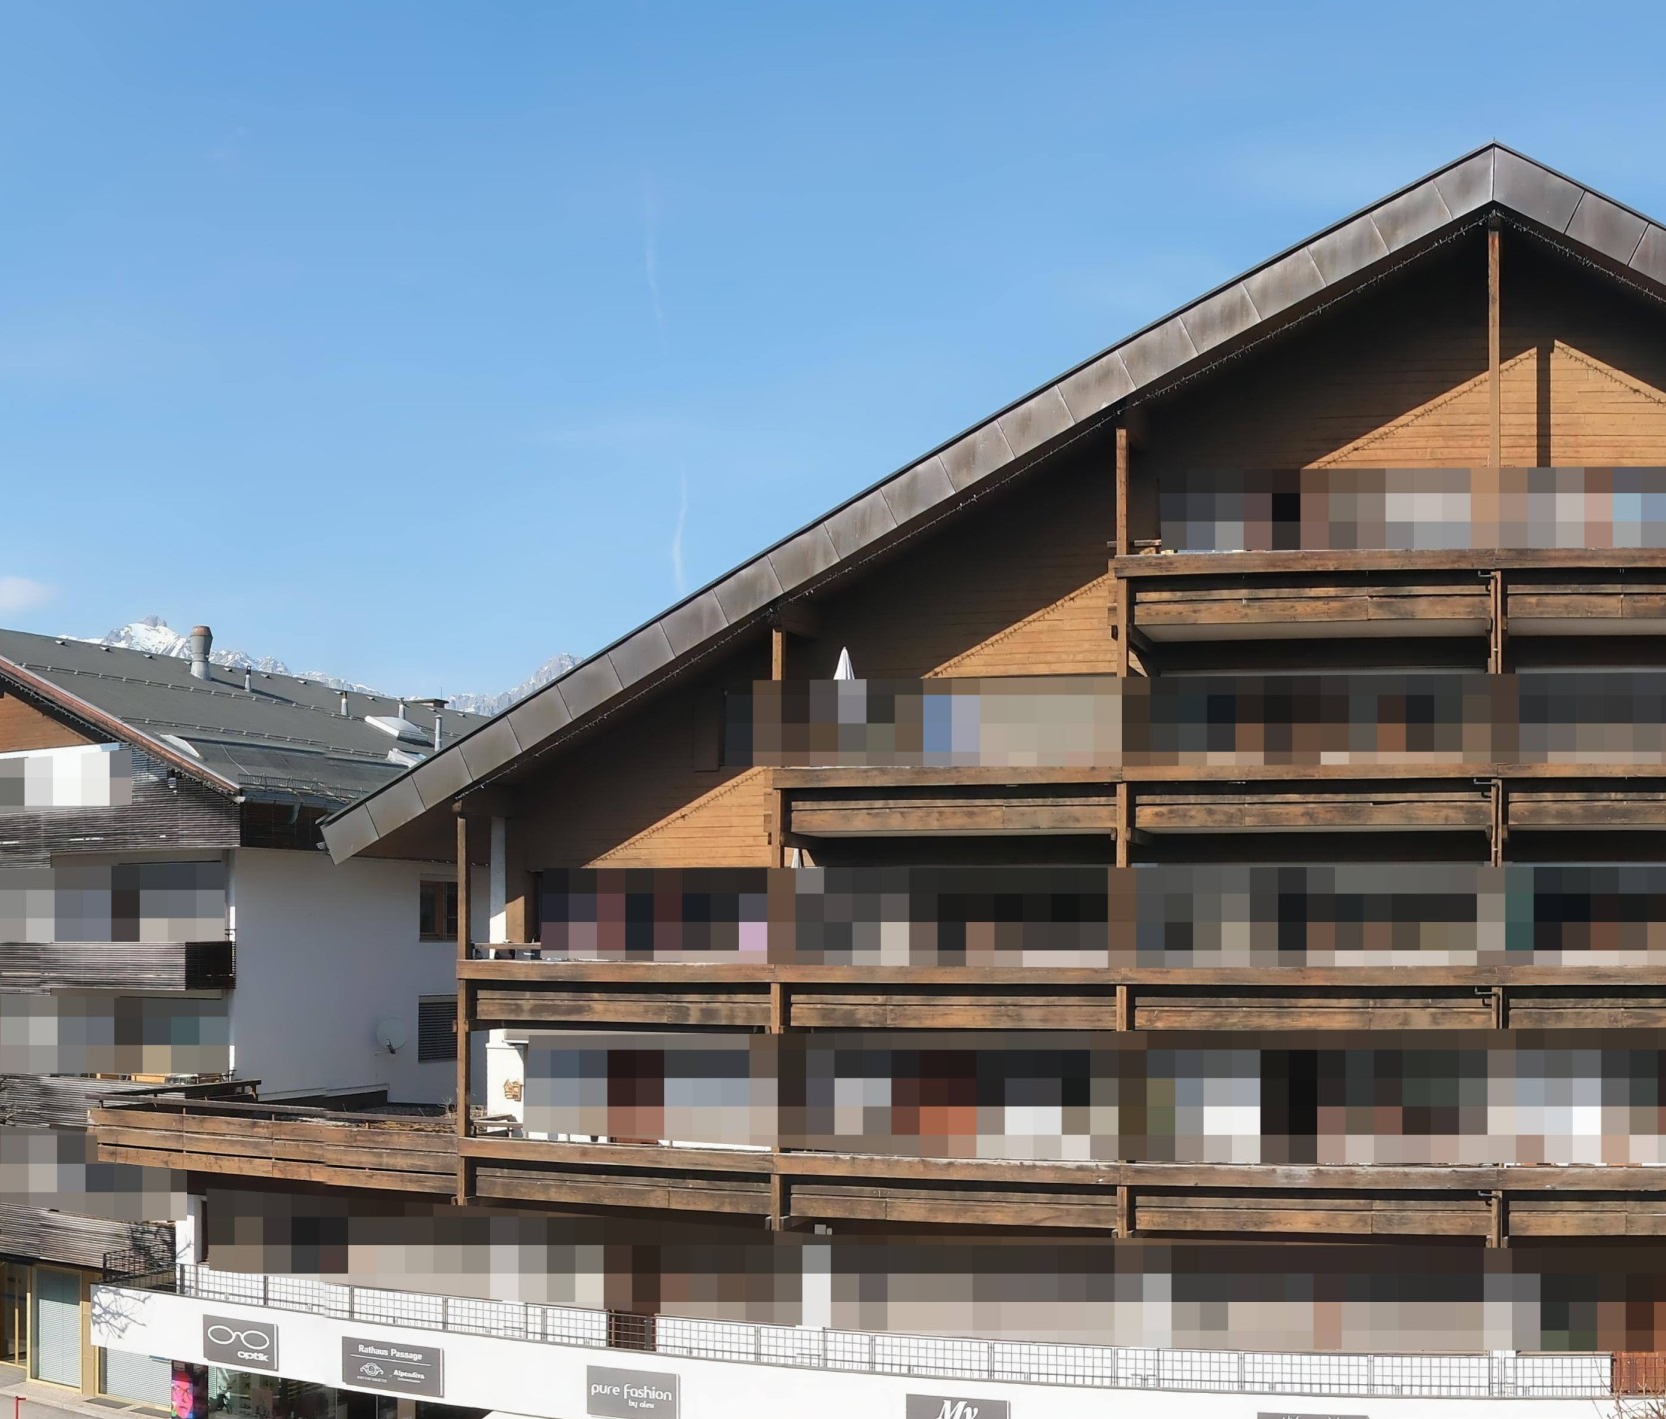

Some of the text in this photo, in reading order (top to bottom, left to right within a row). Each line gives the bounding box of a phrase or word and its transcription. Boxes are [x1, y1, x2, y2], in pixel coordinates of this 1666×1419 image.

[237, 1351, 269, 1362] optik
[358, 1344, 423, 1361] Rathaus Passage
[591, 1383, 621, 1396] pure
[628, 1399, 638, 1408] by
